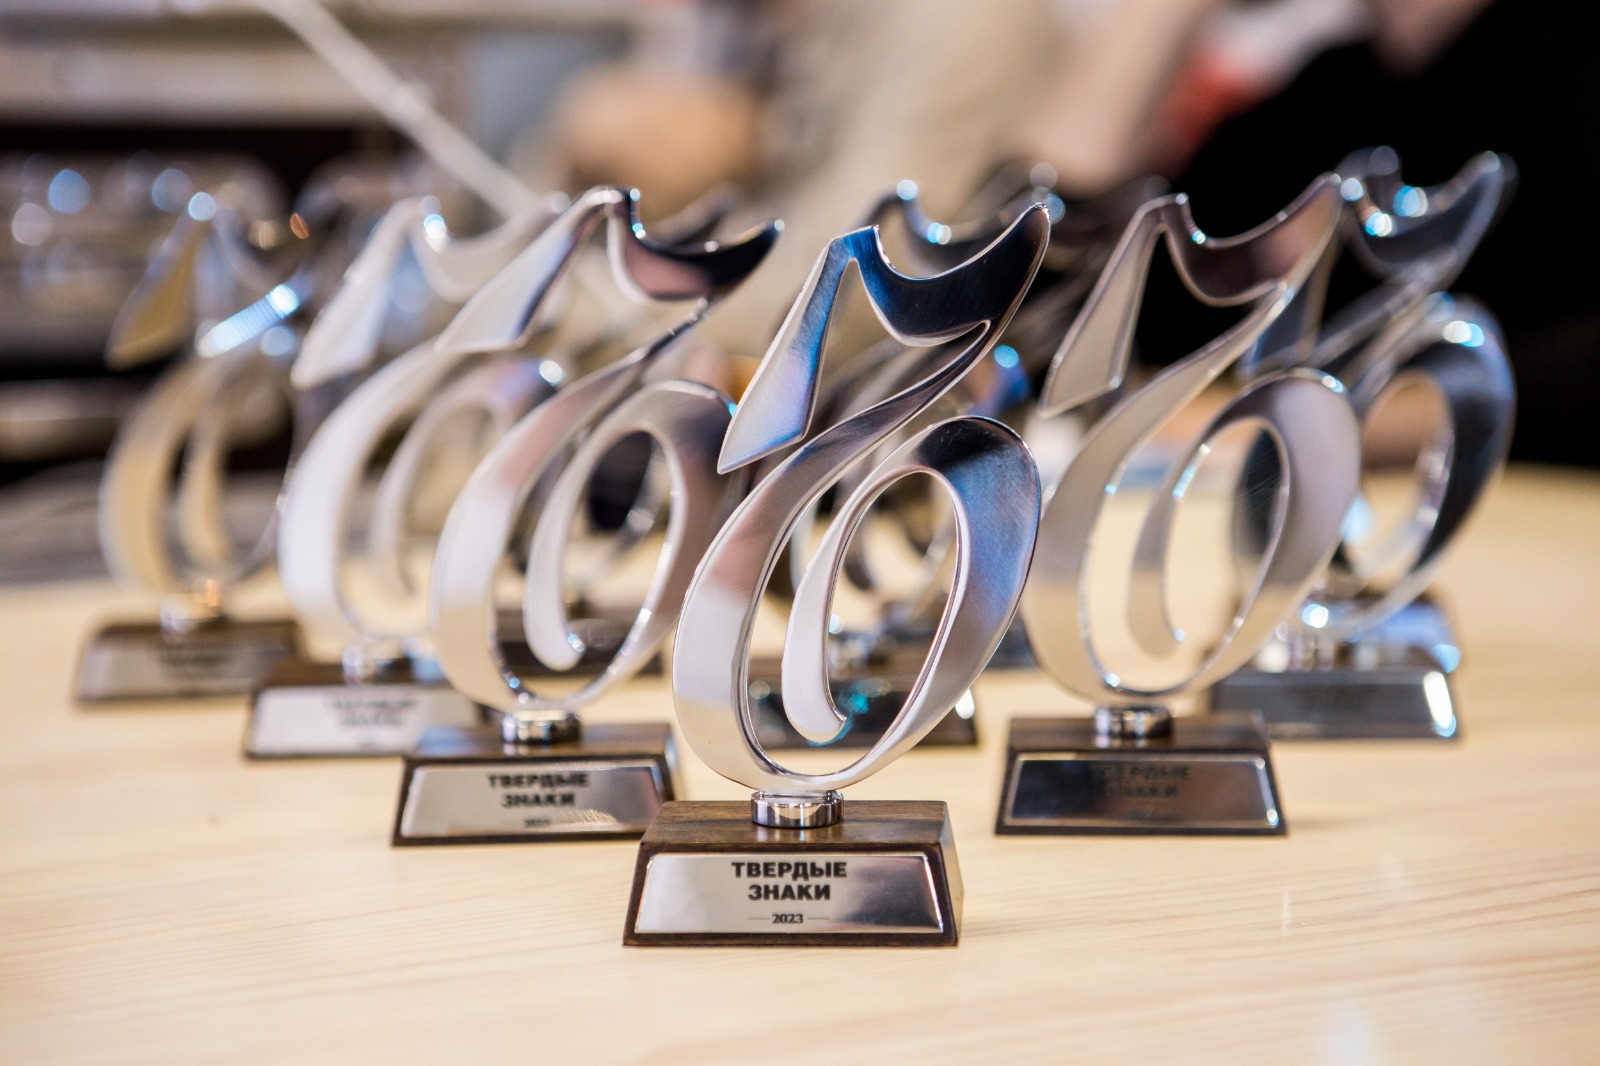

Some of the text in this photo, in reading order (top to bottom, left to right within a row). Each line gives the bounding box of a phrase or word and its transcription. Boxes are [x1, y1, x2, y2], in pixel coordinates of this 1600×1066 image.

[731, 862, 847, 881] ТВЕРДЫЕ
[748, 884, 831, 900] ЗНАКИ
[772, 913, 804, 924] 2023
